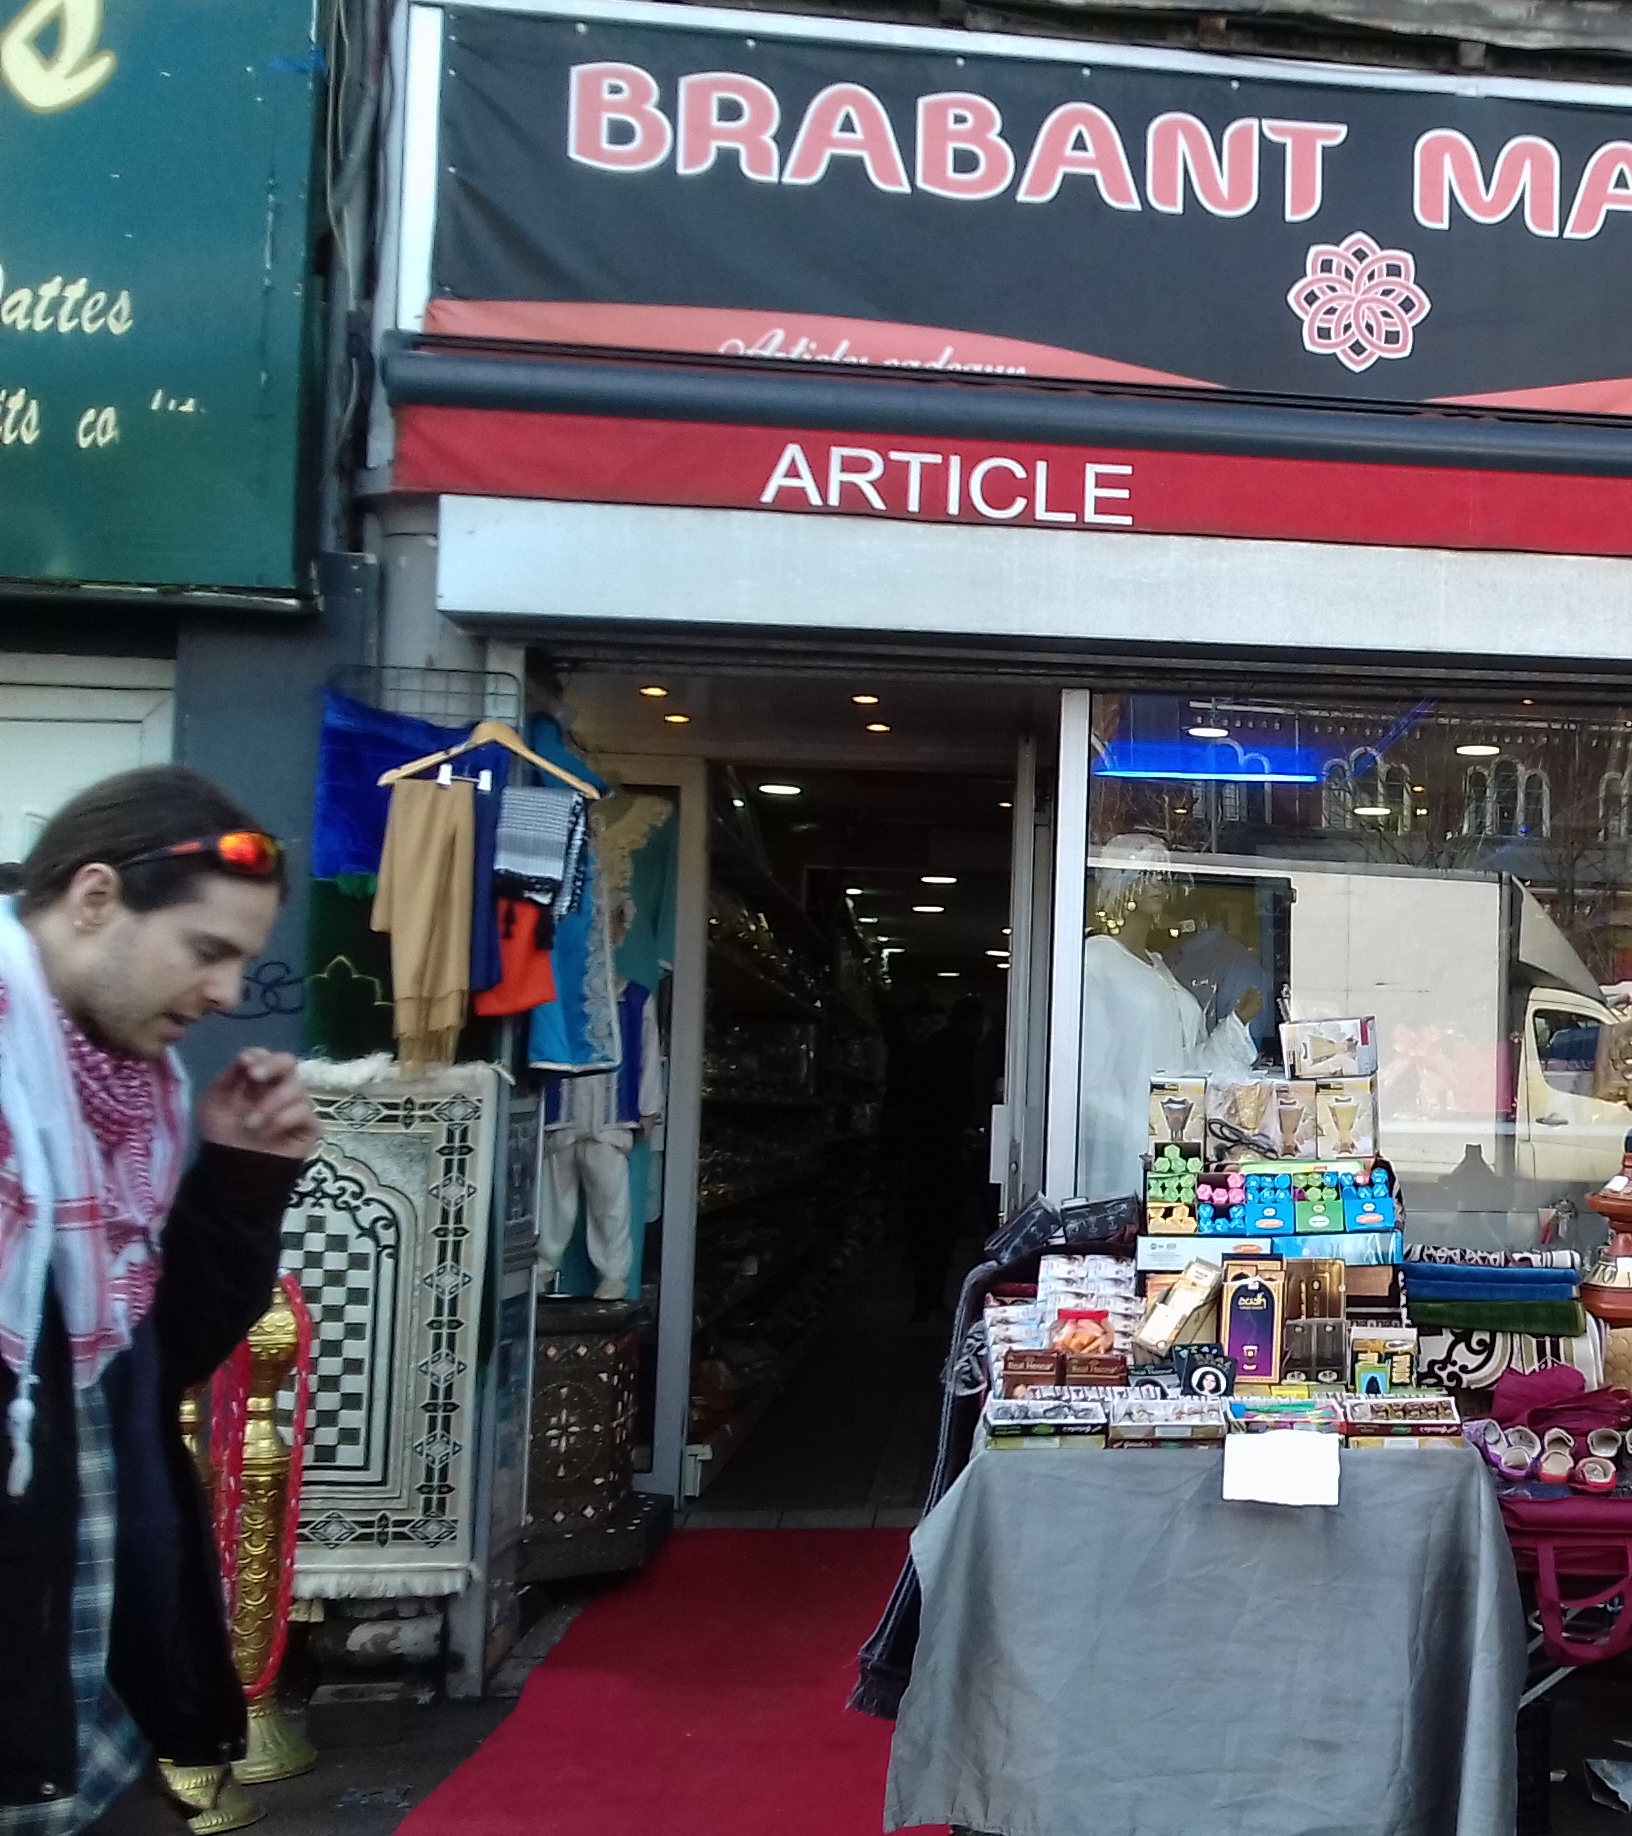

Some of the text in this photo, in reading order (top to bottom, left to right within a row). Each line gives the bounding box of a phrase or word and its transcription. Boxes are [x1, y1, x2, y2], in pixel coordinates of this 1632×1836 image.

[566, 60, 1349, 224] BRABANT
[0, 265, 134, 336] attes
[760, 442, 1135, 526] ARTICLE
